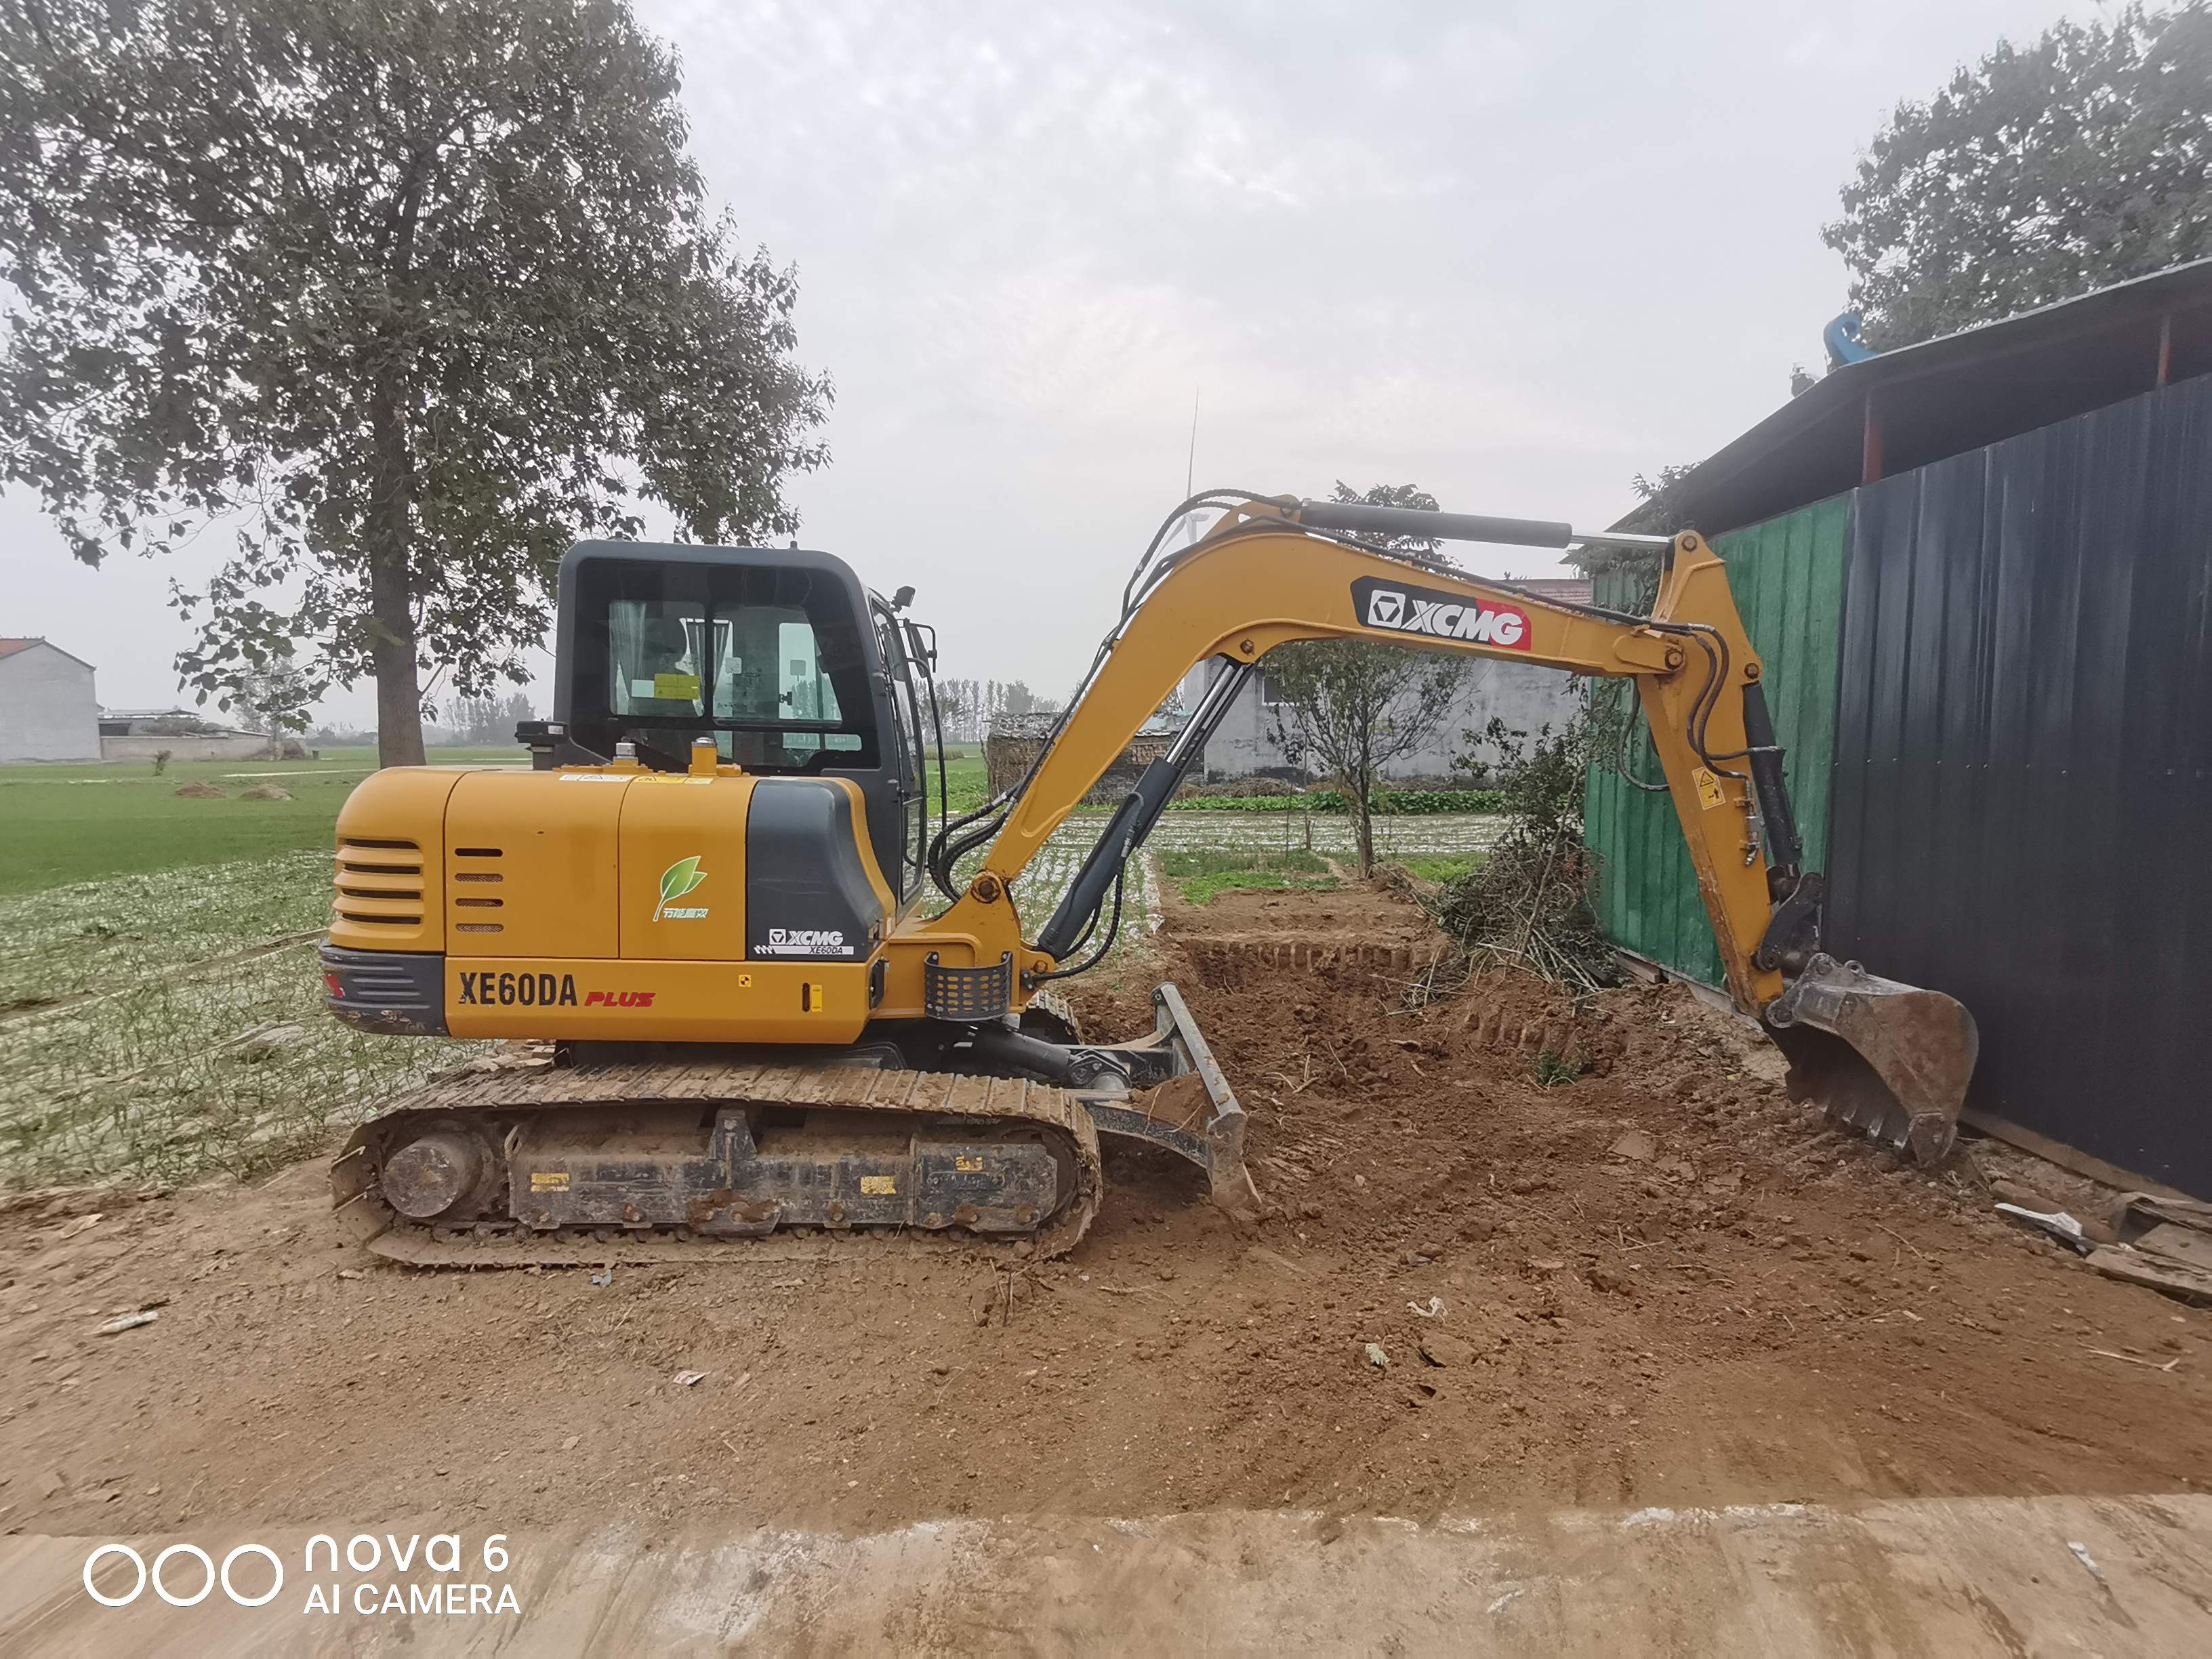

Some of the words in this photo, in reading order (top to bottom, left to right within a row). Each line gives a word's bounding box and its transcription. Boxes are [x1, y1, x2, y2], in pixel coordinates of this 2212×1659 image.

[1401, 600, 1523, 645] XCMG
[786, 930, 844, 946] XCMG
[808, 946, 843, 955] XE60DA
[458, 972, 578, 1006] XE60DA
[583, 991, 656, 1007] PLUS
